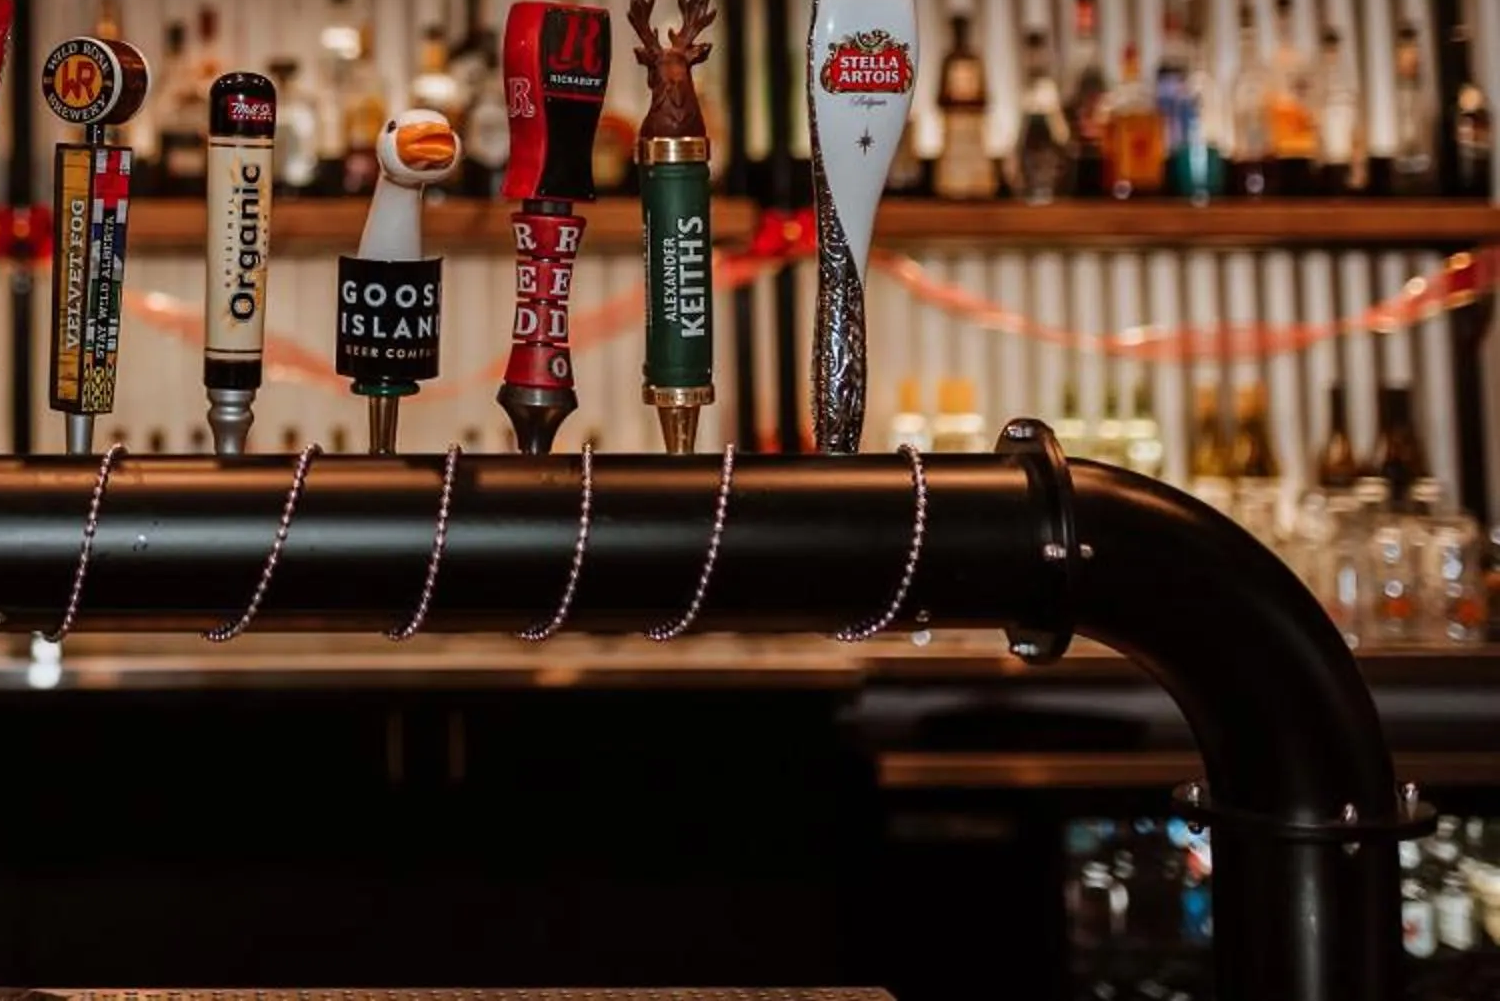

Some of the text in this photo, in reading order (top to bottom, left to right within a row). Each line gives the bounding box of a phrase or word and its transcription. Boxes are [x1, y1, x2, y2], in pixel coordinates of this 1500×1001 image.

[839, 70, 900, 84] ARTOIS
[840, 56, 899, 69] STELLA
[67, 199, 85, 349] VELVET FOG
[230, 164, 261, 320] Organic
[663, 237, 677, 321] ALEXANDER
[678, 216, 705, 337] KEITH'S
[95, 214, 115, 359] STAY WILD ALBERTA
[342, 280, 441, 308] GOOS
[342, 312, 440, 339] ISLAN
